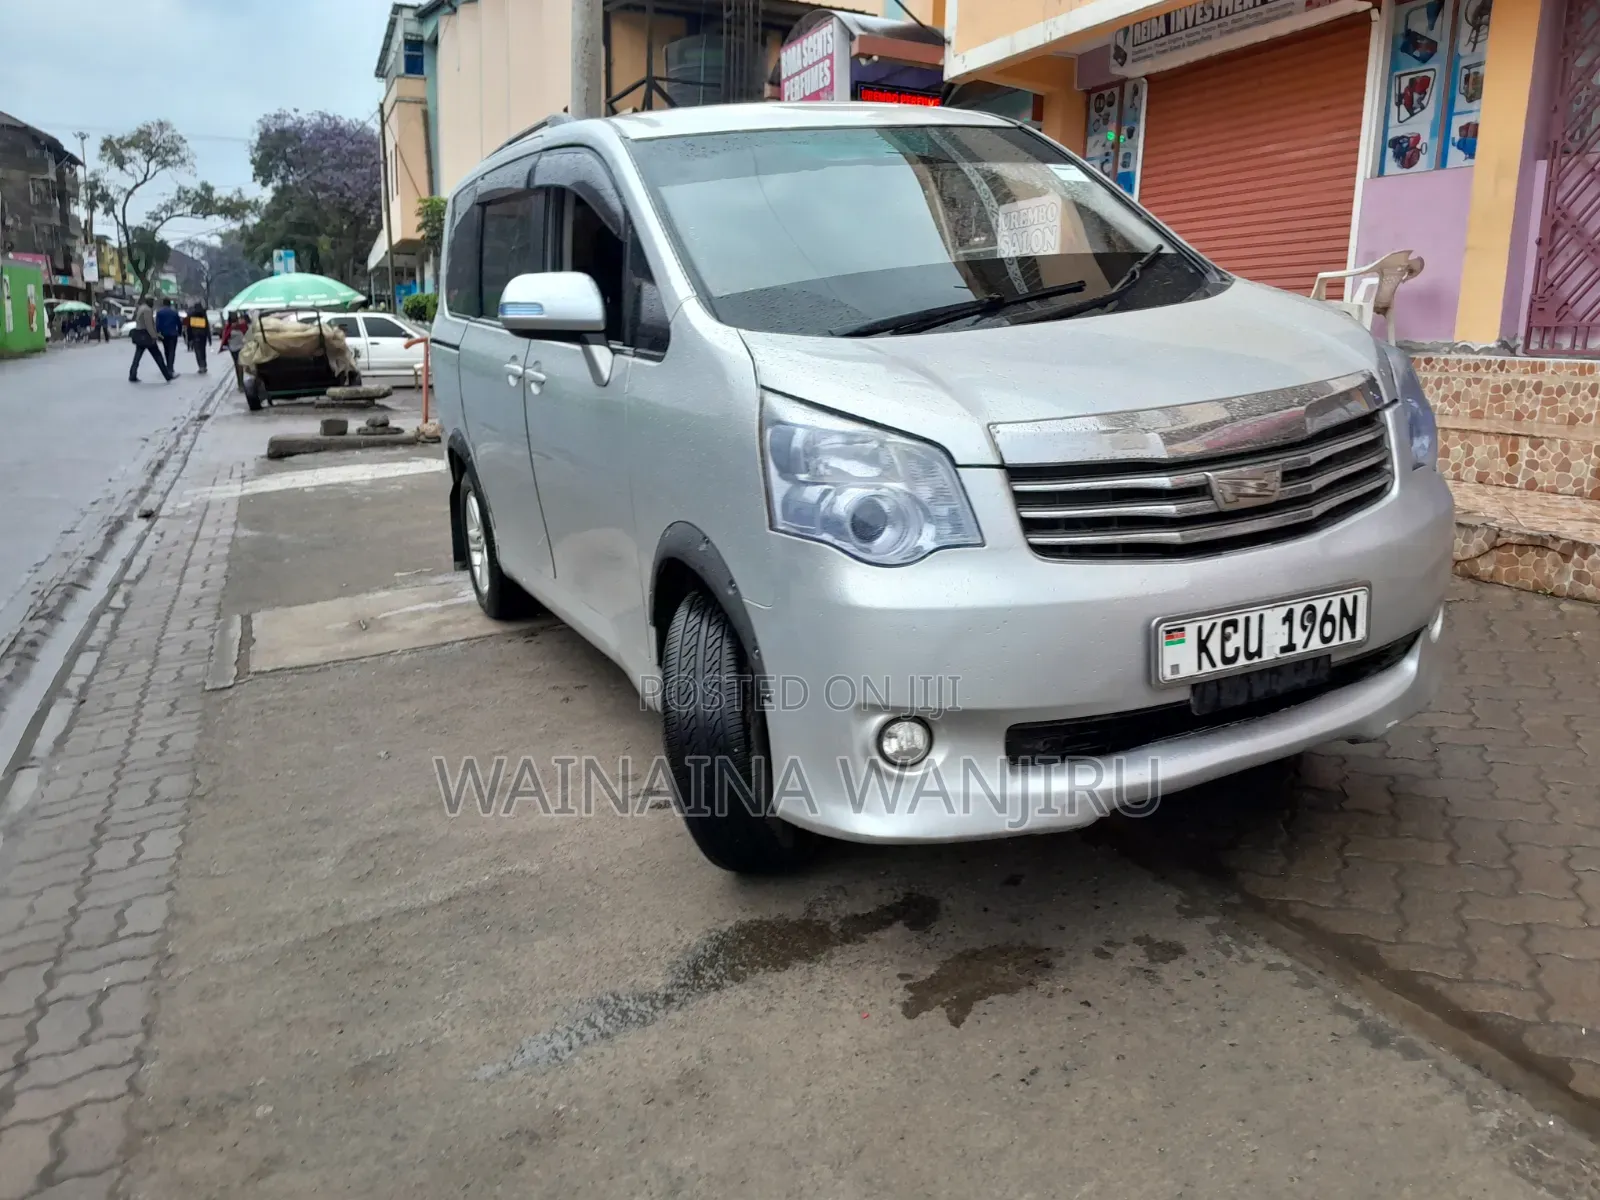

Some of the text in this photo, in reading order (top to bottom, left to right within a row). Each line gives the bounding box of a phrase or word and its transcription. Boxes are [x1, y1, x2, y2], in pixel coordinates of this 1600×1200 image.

[784, 58, 831, 101] PERFUMES
[1000, 201, 1058, 232] UREMBO
[1000, 225, 1058, 257] SALON
[1196, 594, 1358, 671] KCU 196N
